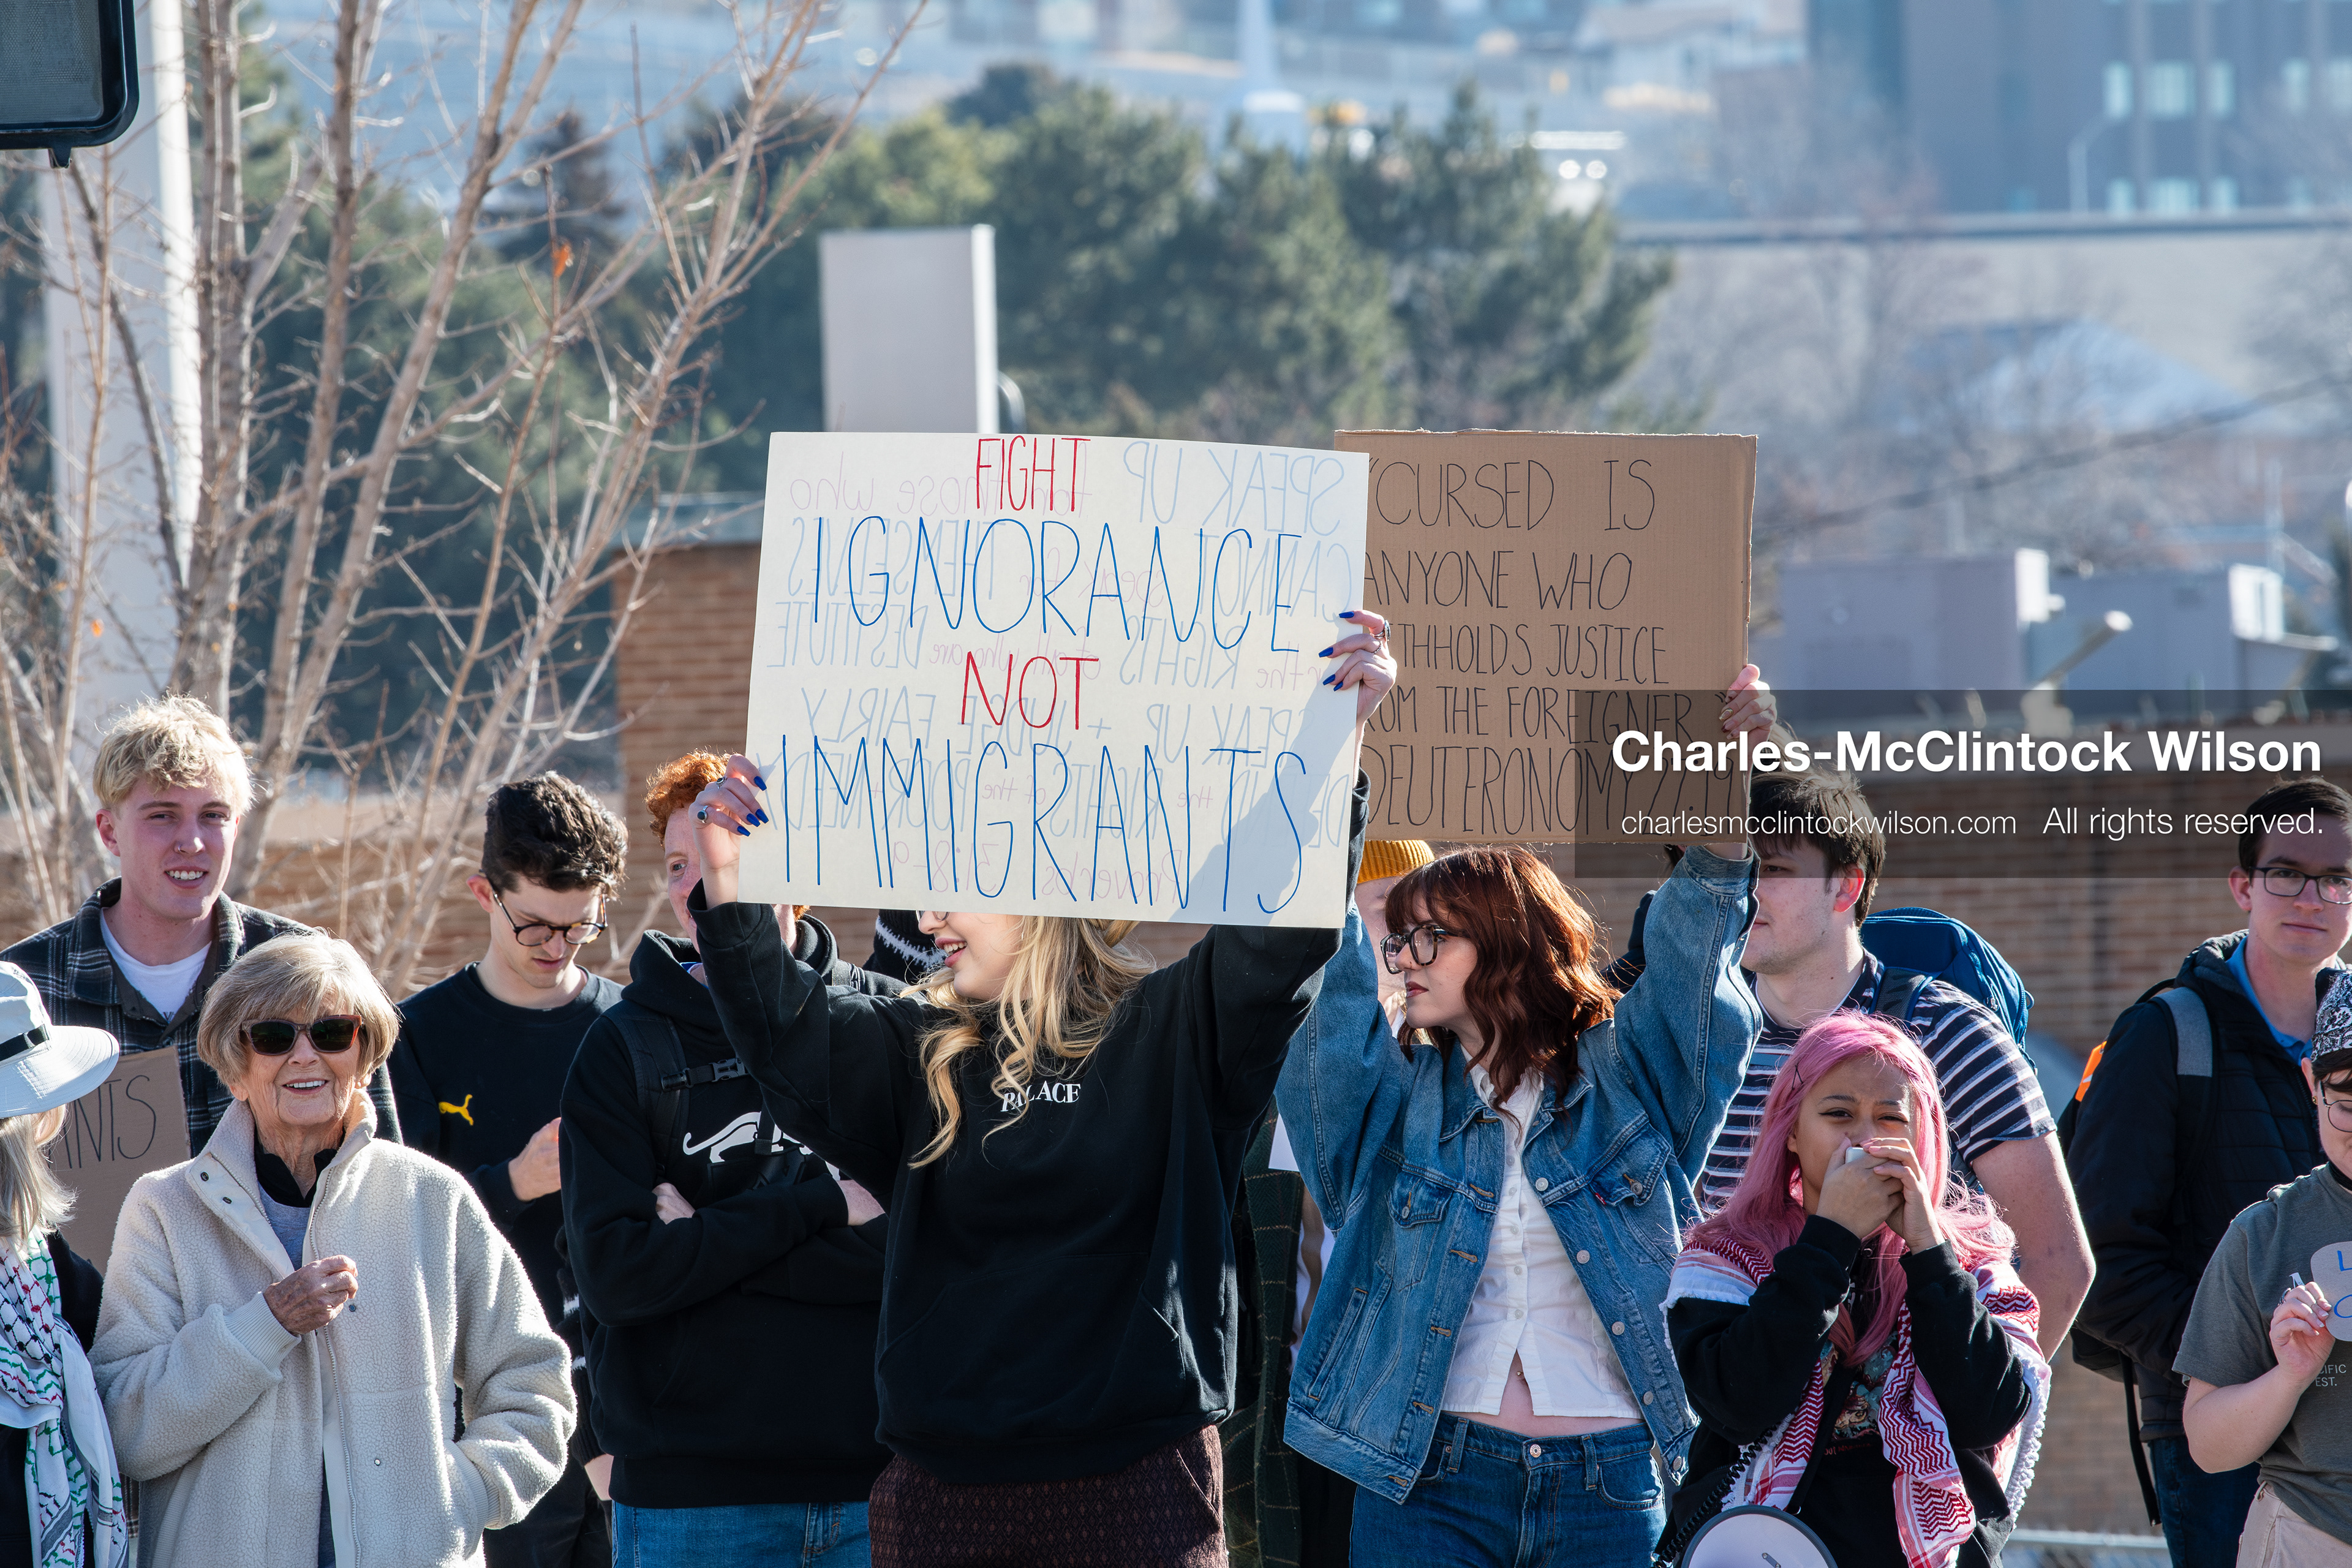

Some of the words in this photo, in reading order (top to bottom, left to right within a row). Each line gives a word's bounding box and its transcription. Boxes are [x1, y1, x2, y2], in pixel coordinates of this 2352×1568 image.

[975, 435, 1091, 512] FIGHT
[1604, 459, 1656, 531] IS
[813, 515, 1303, 652] IGNORANCE
[1364, 550, 1514, 609] ANYONE
[1532, 551, 1632, 611] WHO
[962, 650, 1100, 730] NOT
[1388, 623, 1532, 676] THHOLDS
[1546, 623, 1670, 685] JUSTICE
[1367, 684, 1418, 733] OM
[1436, 686, 1489, 736] THE
[782, 734, 1307, 913] IMMIGRANTS
[1361, 744, 1640, 836] DEUTERONOMY
[64, 1074, 157, 1169] NTS
[1000, 1080, 1081, 1112] PALACE
